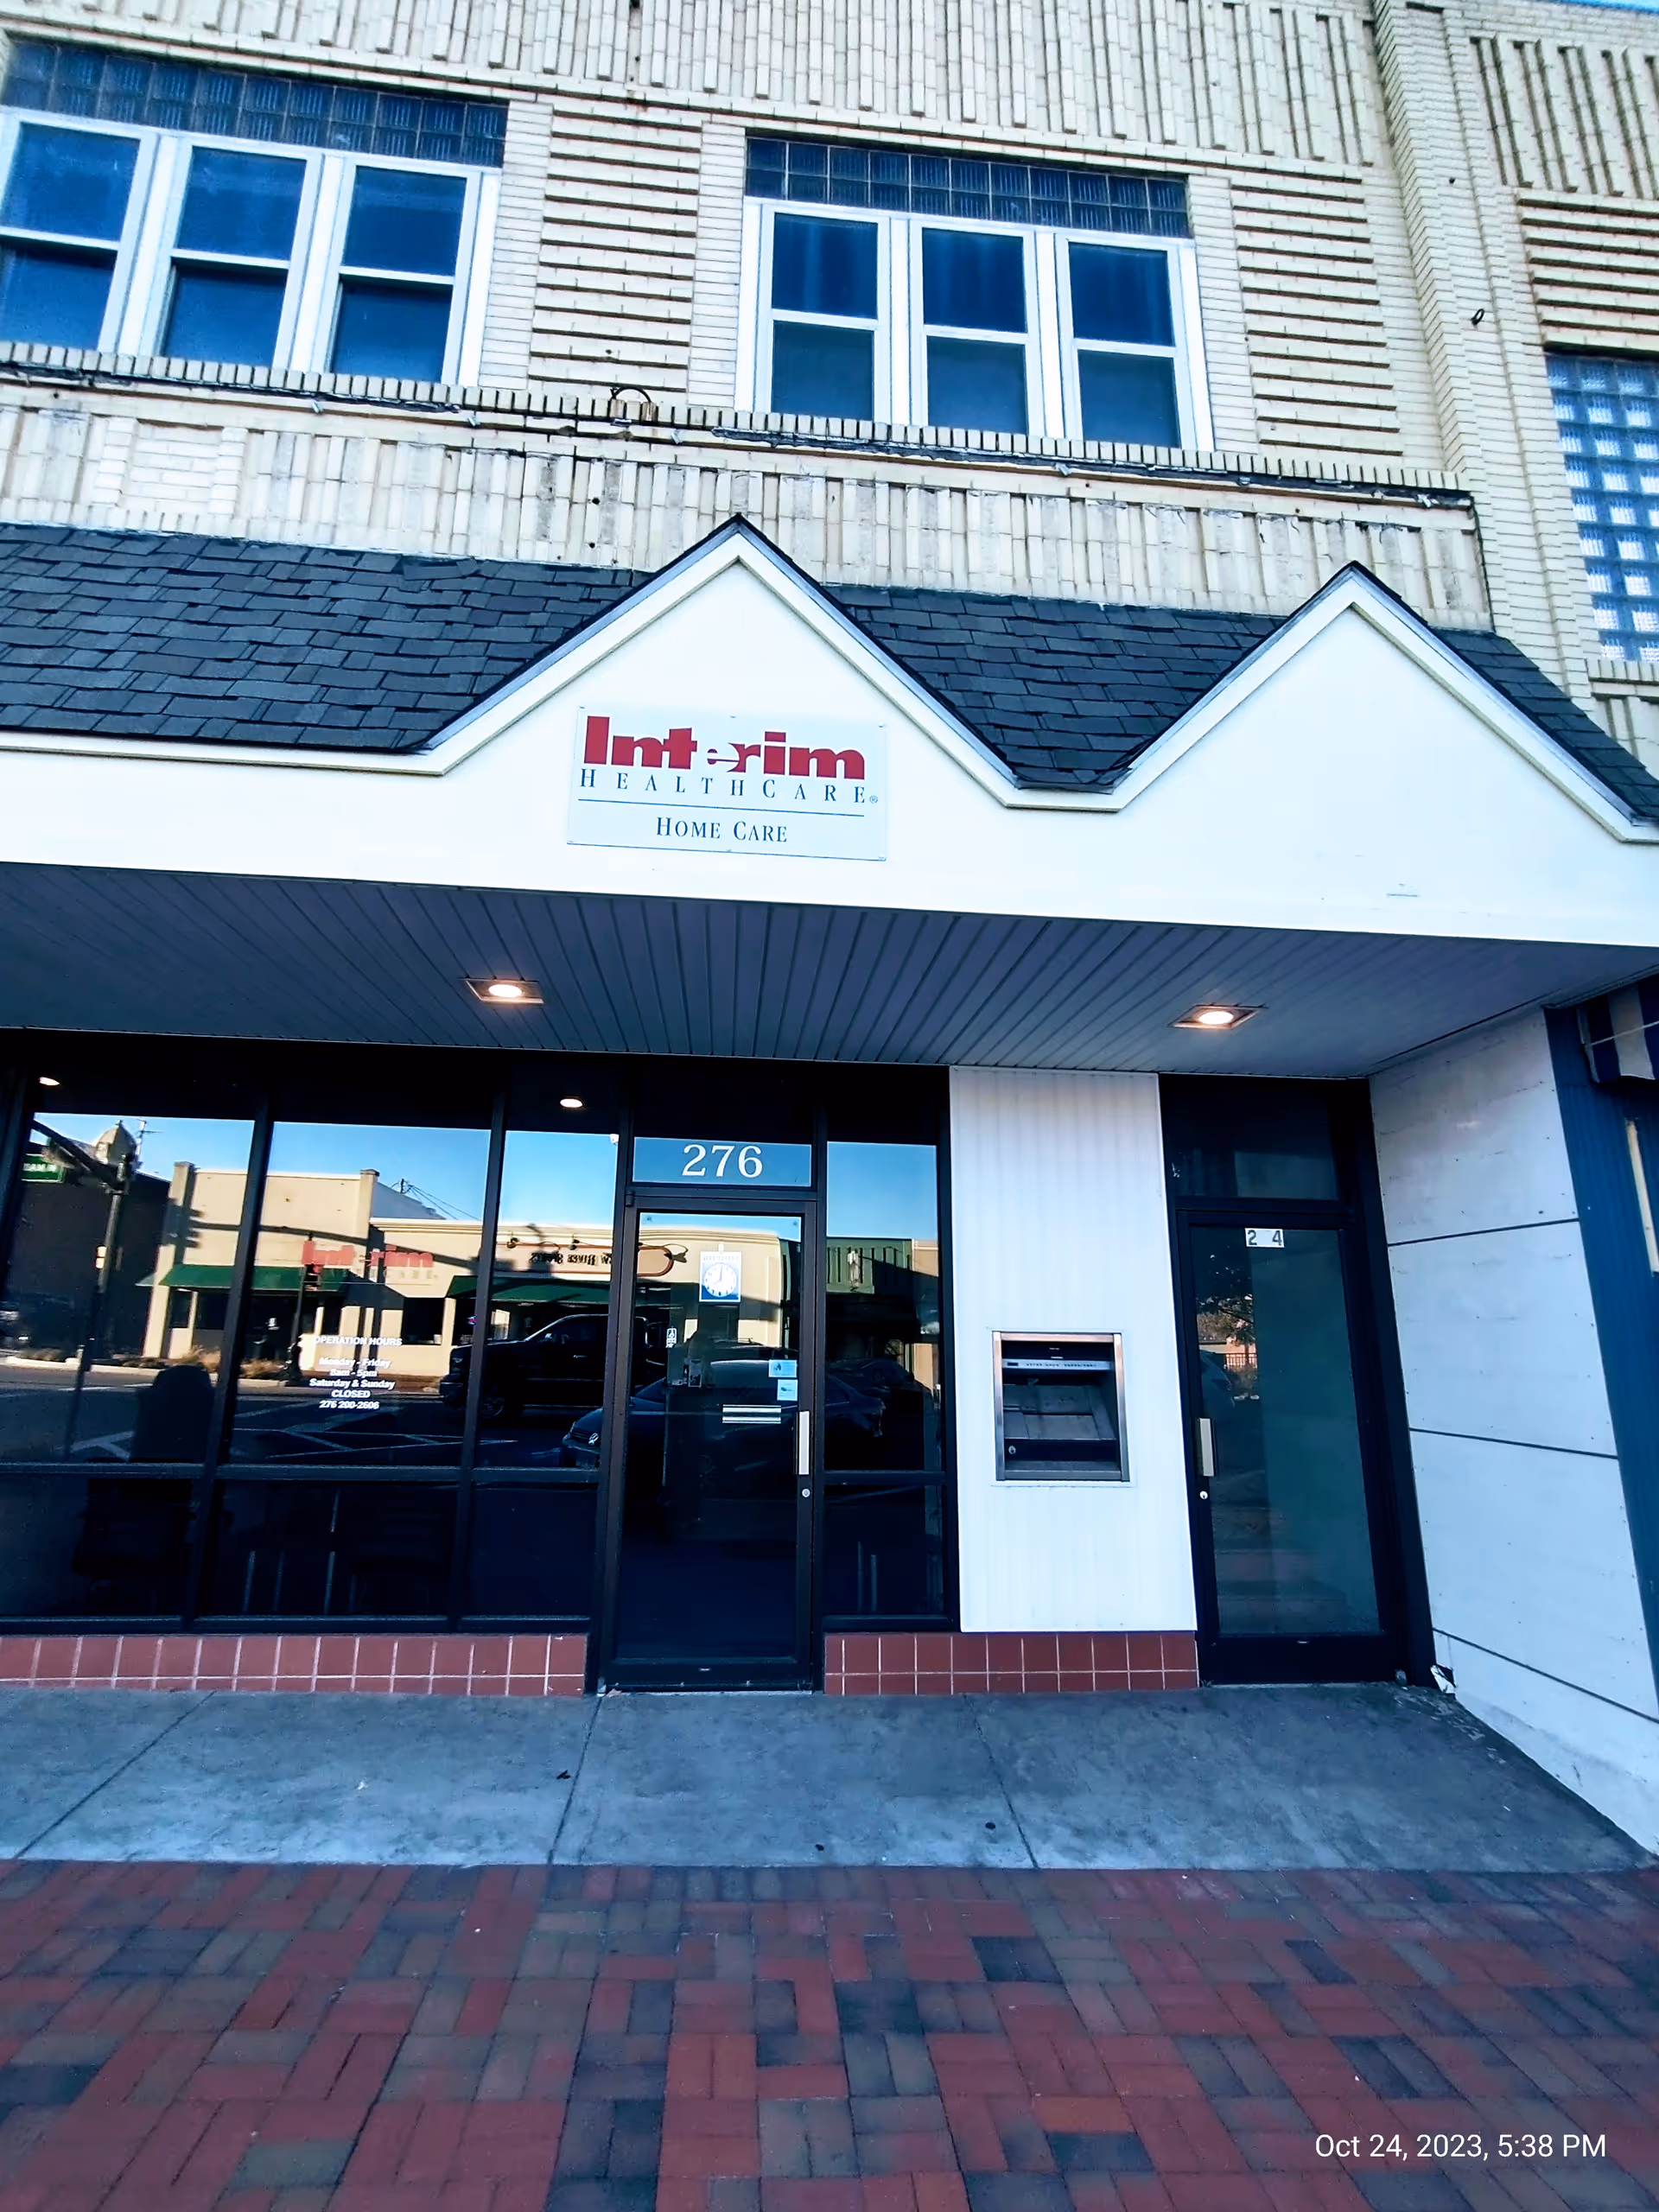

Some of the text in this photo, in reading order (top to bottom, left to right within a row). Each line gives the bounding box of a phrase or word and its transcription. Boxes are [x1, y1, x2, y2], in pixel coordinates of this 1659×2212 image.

[583, 715, 865, 780] Interim
[657, 817, 787, 842] HOME CARE
[682, 1144, 762, 1179] 276
[1247, 1230, 1282, 1246] 2 4
[315, 1336, 403, 1346] OPERATION HOURS
[309, 1378, 351, 1389] Saturday
[360, 1380, 396, 1390] Sunday
[331, 1389, 371, 1398] CLOSED
